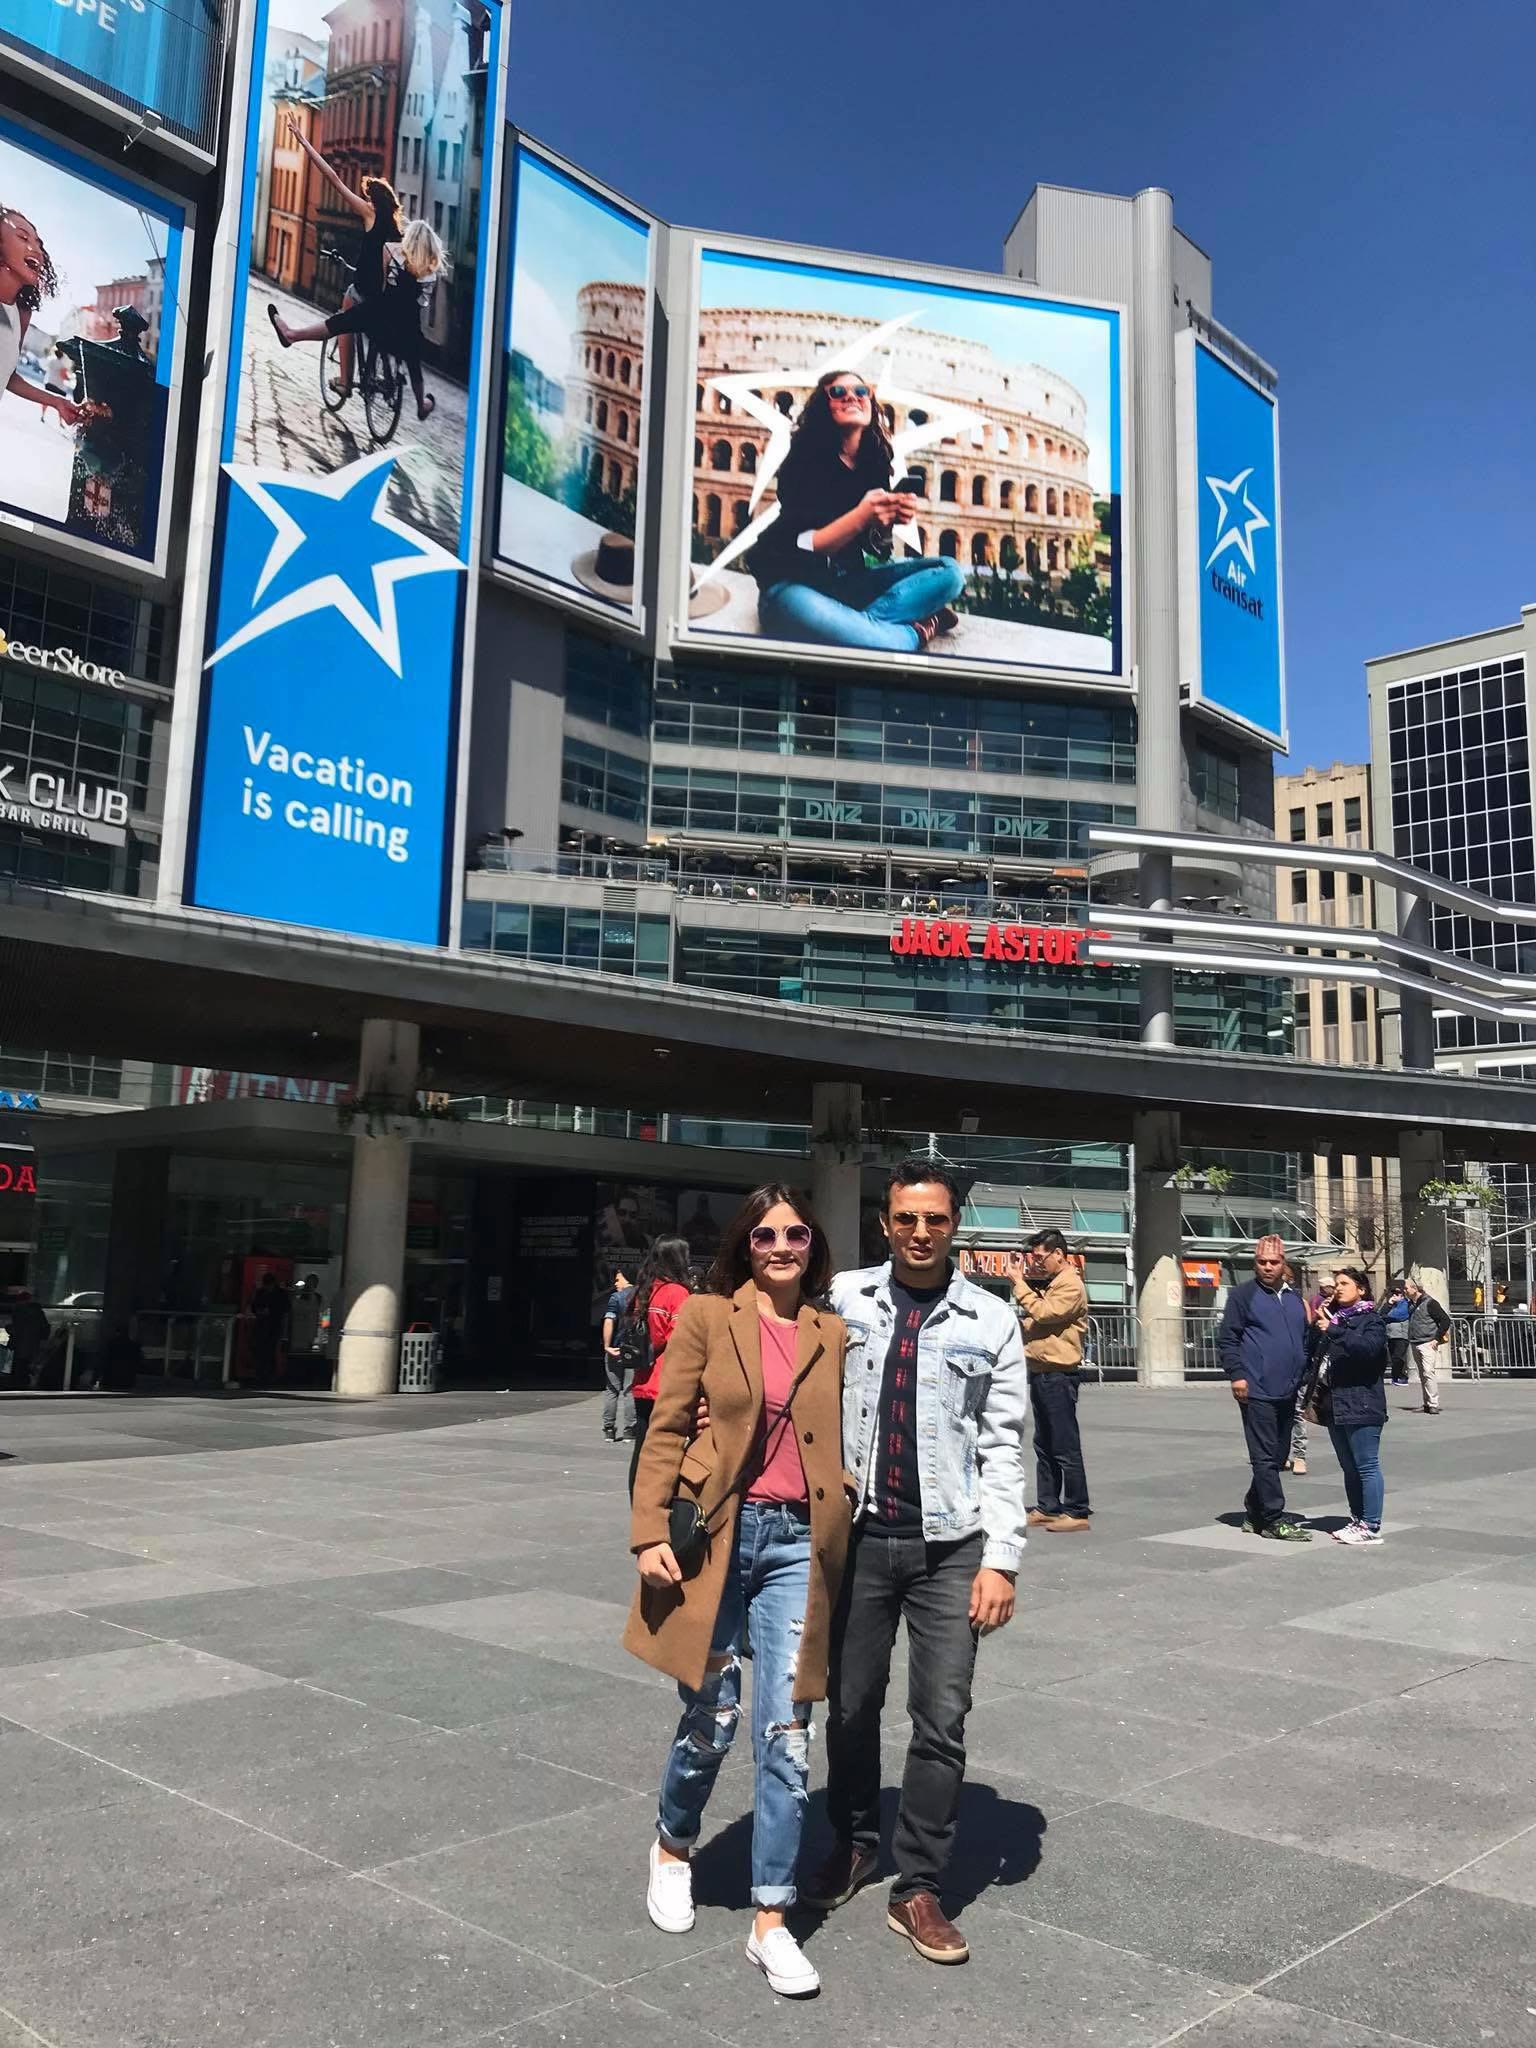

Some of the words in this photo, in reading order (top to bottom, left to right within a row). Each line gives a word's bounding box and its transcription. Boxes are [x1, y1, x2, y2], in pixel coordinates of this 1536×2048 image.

[1227, 559, 1247, 588] Air
[1211, 567, 1264, 621] transat
[243, 725, 413, 807] Vacation
[29, 772, 128, 826] CLUB
[805, 799, 862, 823] DMZ
[900, 808, 956, 832] DMZ
[994, 815, 1049, 839] DMZ
[40, 811, 88, 837] GRILL
[241, 777, 273, 821] is
[284, 801, 409, 863] calling
[891, 918, 972, 958] JACK
[963, 1252, 997, 1273] BLAZE
